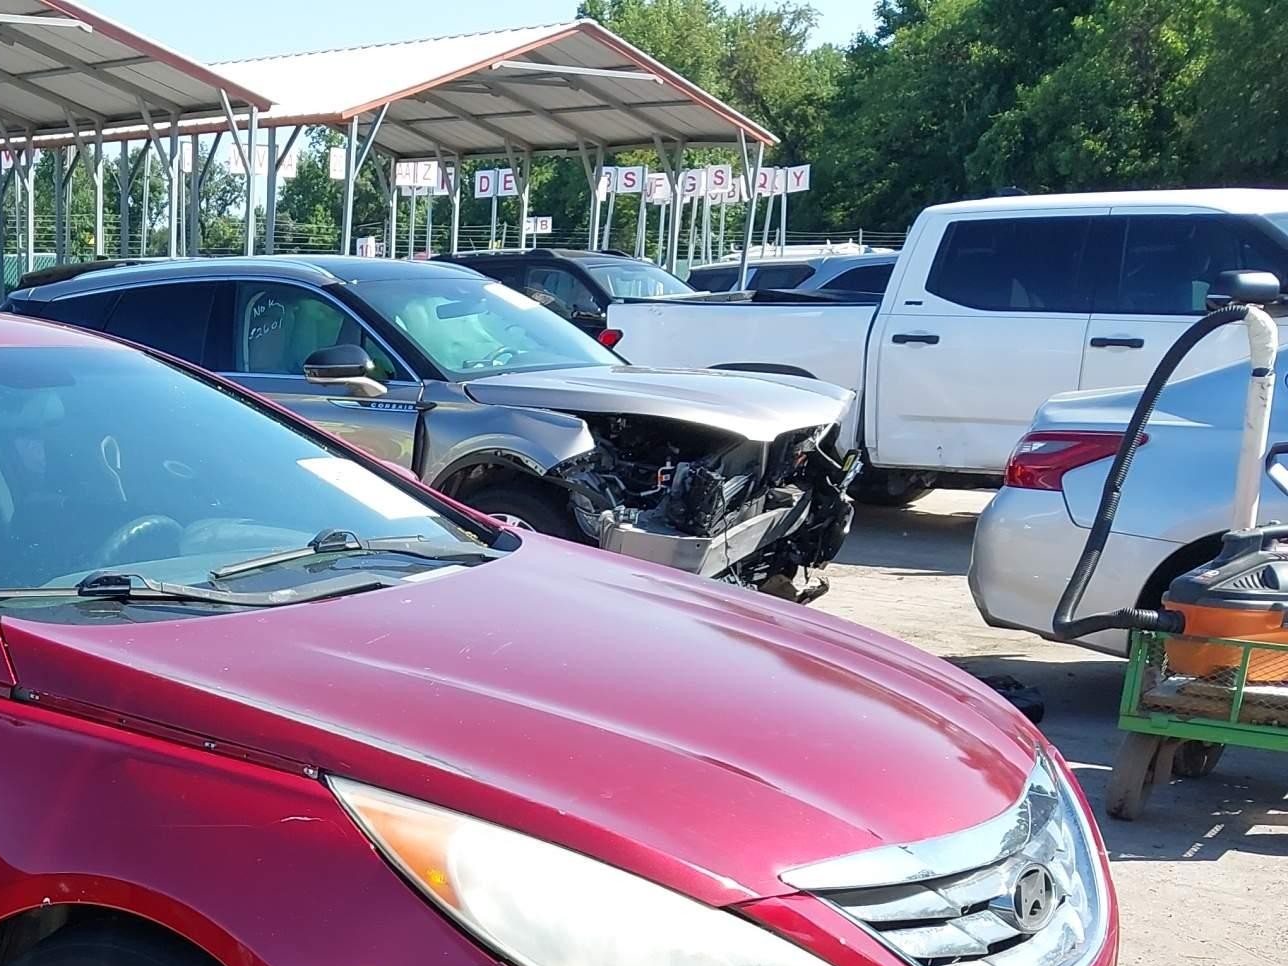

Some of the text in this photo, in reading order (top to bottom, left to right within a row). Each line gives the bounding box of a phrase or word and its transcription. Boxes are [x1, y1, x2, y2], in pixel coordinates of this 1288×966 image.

[423, 163, 432, 180] Z
[623, 171, 636, 188] S
[713, 169, 725, 186] S
[792, 170, 805, 187] Y
[479, 173, 514, 193] D E
[540, 219, 549, 231] B
